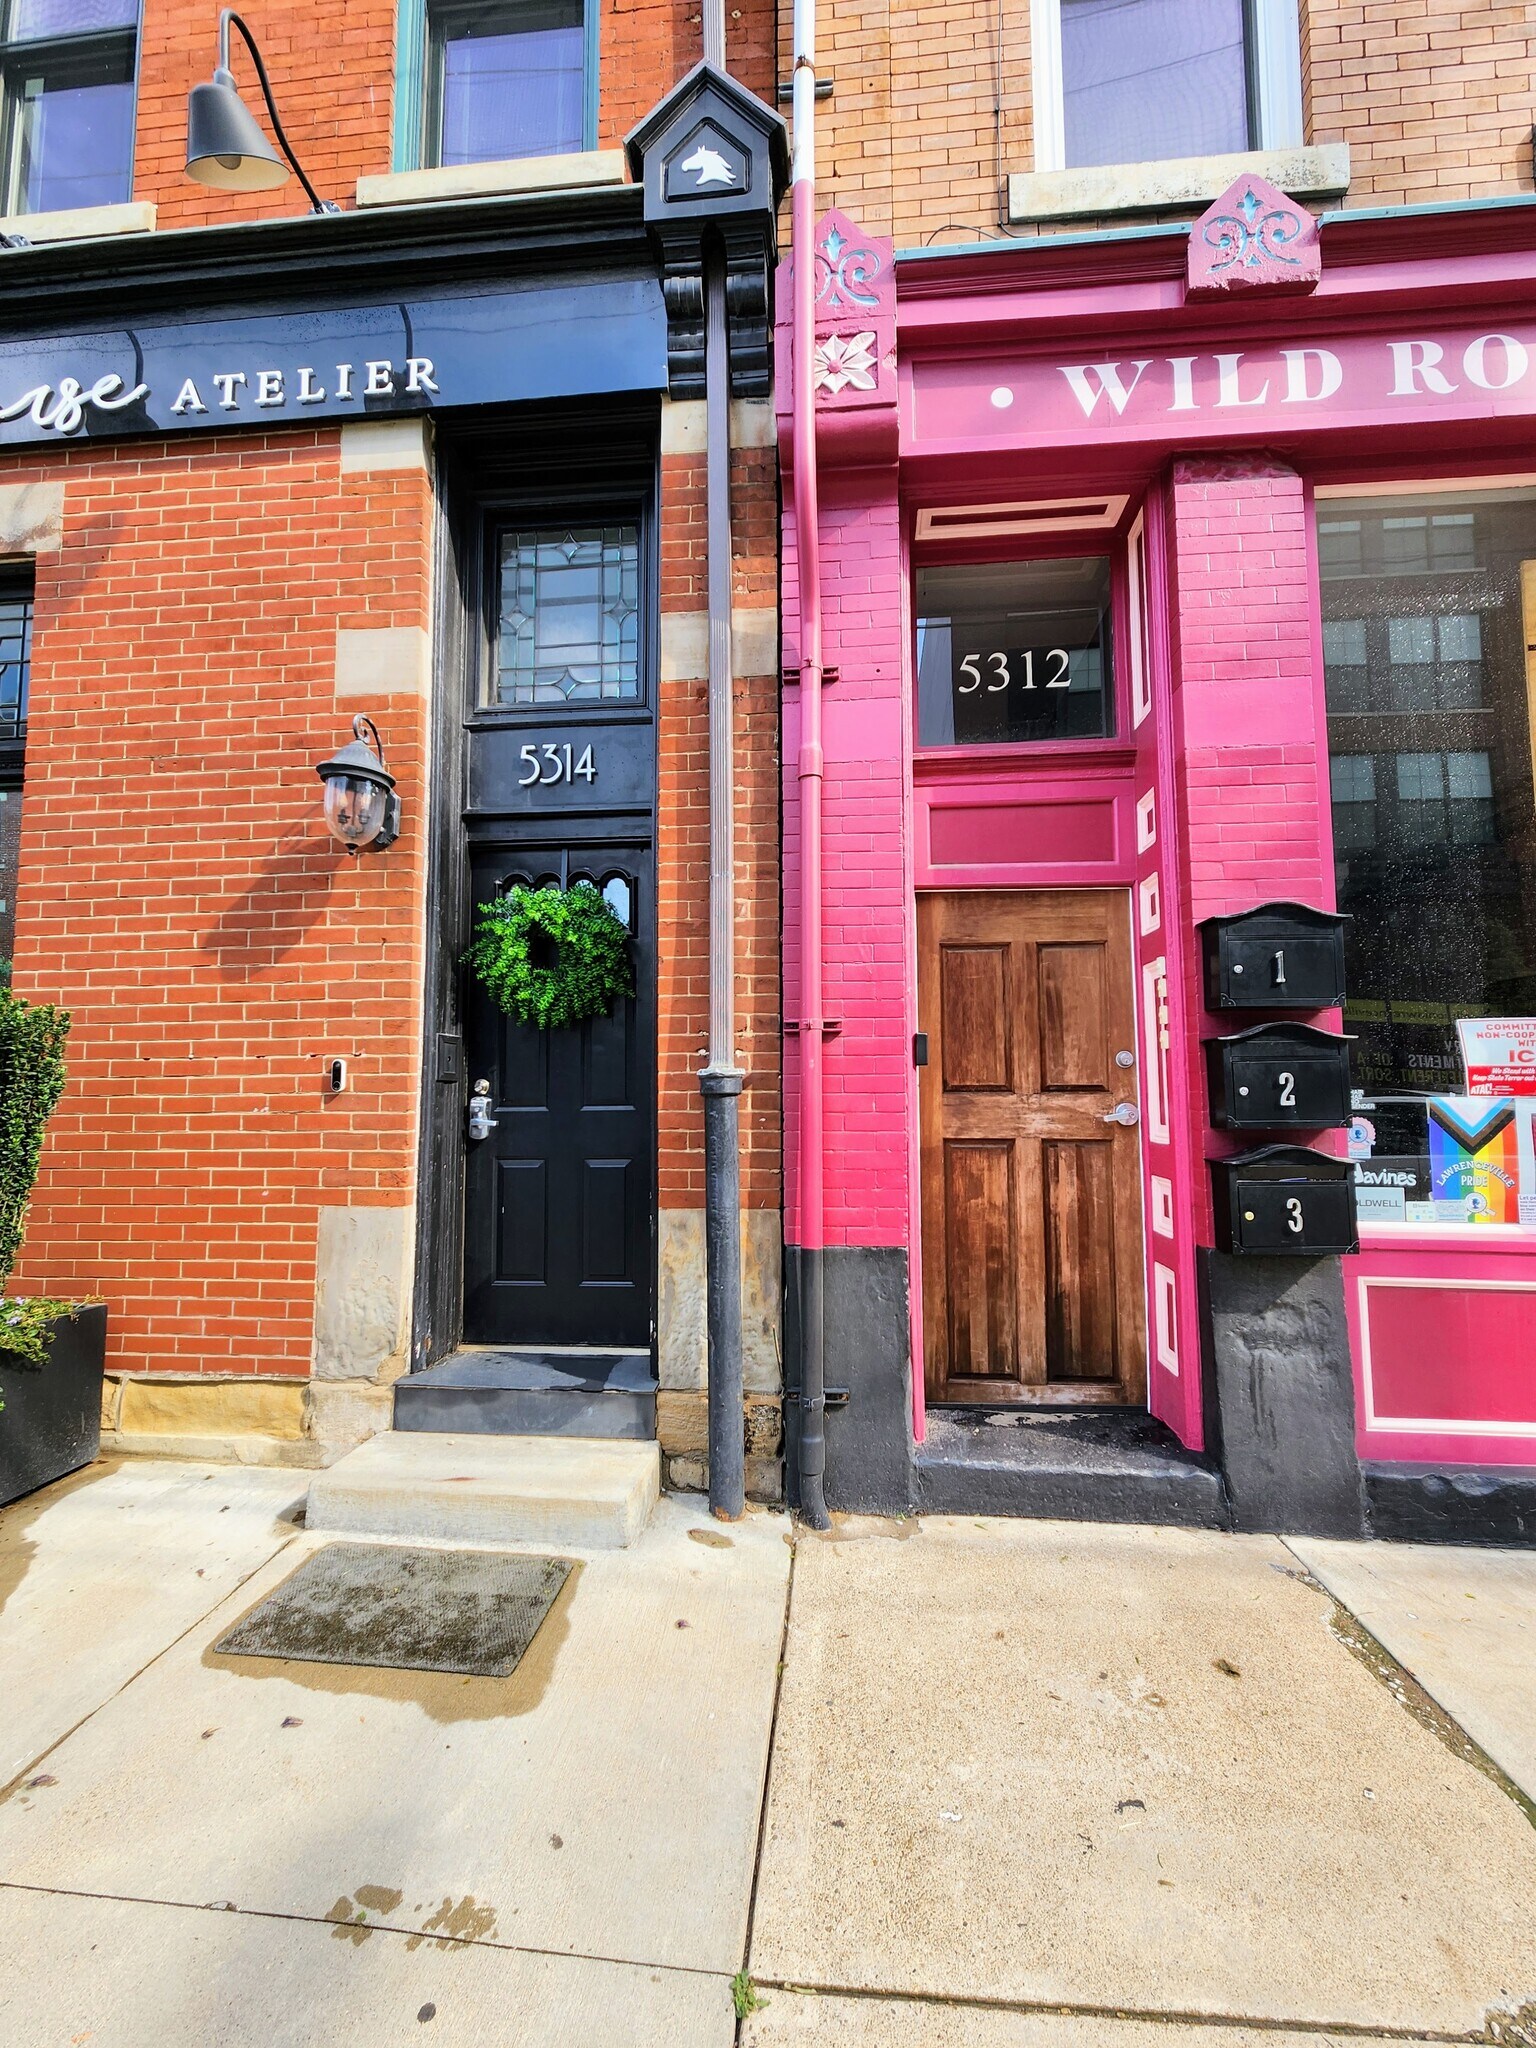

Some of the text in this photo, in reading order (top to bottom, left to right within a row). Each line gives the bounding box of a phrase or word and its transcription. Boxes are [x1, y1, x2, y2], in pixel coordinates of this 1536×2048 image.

[170, 357, 439, 414] ATELIER
[1056, 334, 1529, 418] WILD RO
[958, 649, 1072, 693] 5312
[518, 743, 596, 785] 5314
[1275, 950, 1287, 984] 1
[1278, 1072, 1296, 1106] 2
[1436, 1161, 1515, 1188] LAWRENCEVILLE
[1461, 1175, 1488, 1186] PRIDE
[1286, 1198, 1304, 1233] 3
